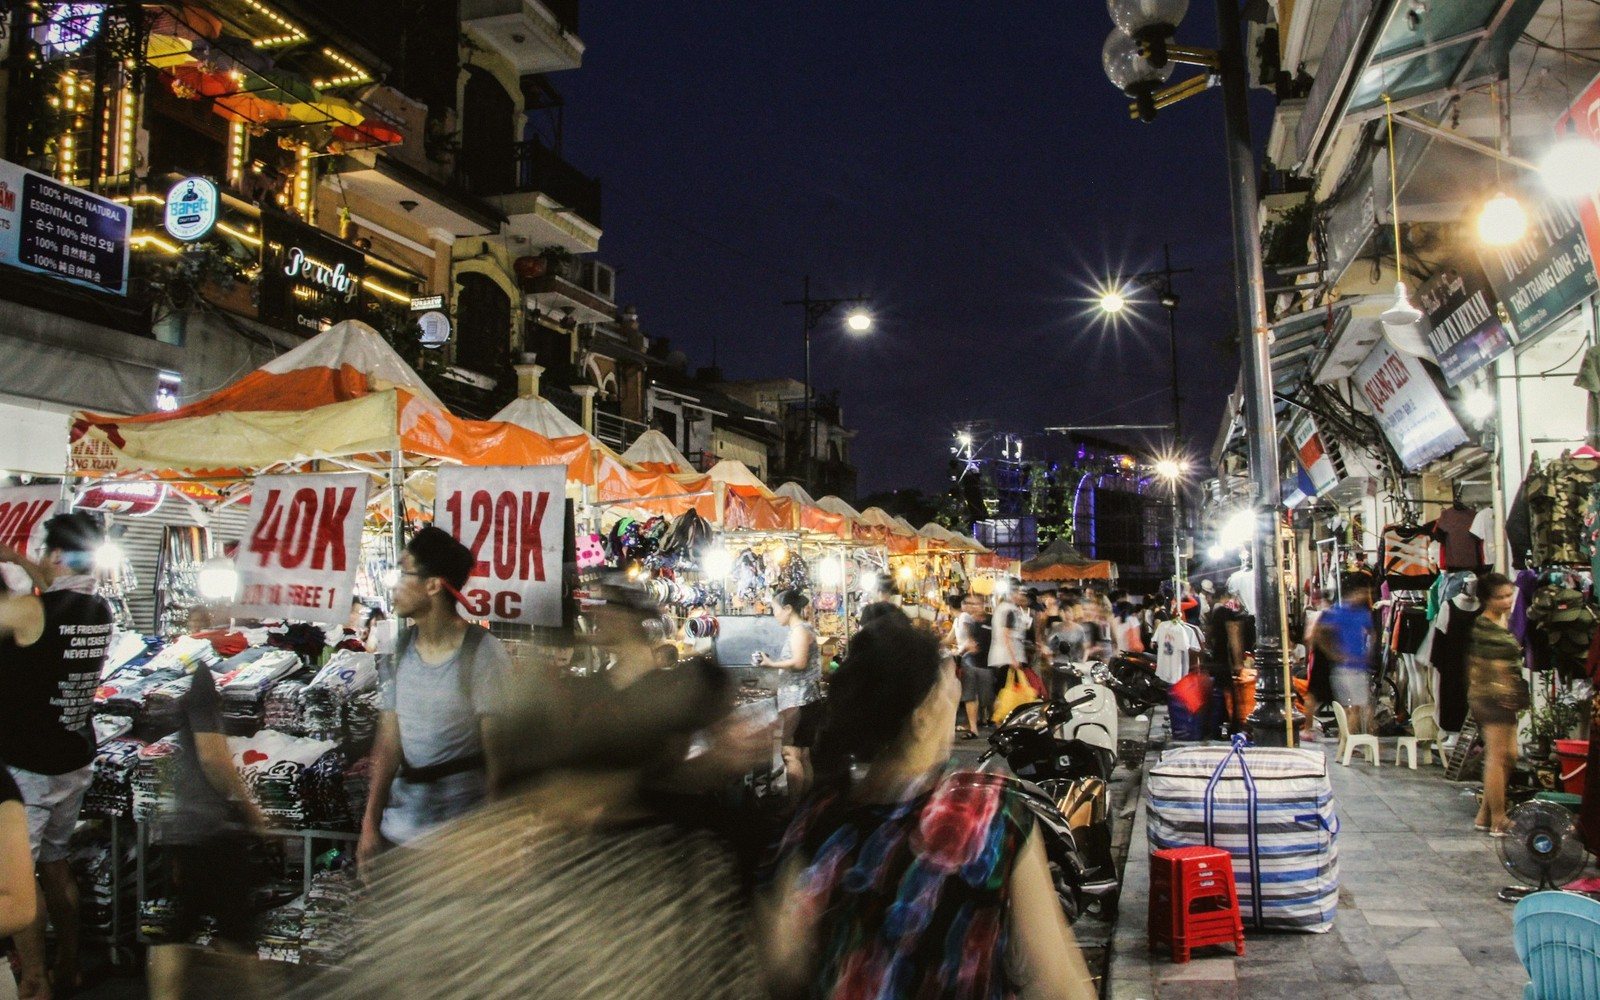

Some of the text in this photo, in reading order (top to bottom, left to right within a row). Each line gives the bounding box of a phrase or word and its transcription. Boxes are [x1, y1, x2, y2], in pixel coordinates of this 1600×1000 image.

[30, 199, 88, 227] ESSENTIAL OIL
[39, 184, 121, 222] 100% PURE NATURAL
[169, 197, 208, 216] Barett
[56, 225, 79, 241] 100%
[35, 236, 58, 252] 100%
[34, 254, 57, 270] 100%
[285, 247, 357, 303] Peachy
[1525, 268, 1555, 302] TRANG
[1451, 290, 1491, 337] VIETNAM
[249, 486, 357, 571] 40K
[446, 490, 550, 581] 120K
[328, 588, 335, 609] 1
[59, 624, 77, 635] THE
[70, 636, 87, 647] CAN
[63, 649, 89, 659] NEVER
